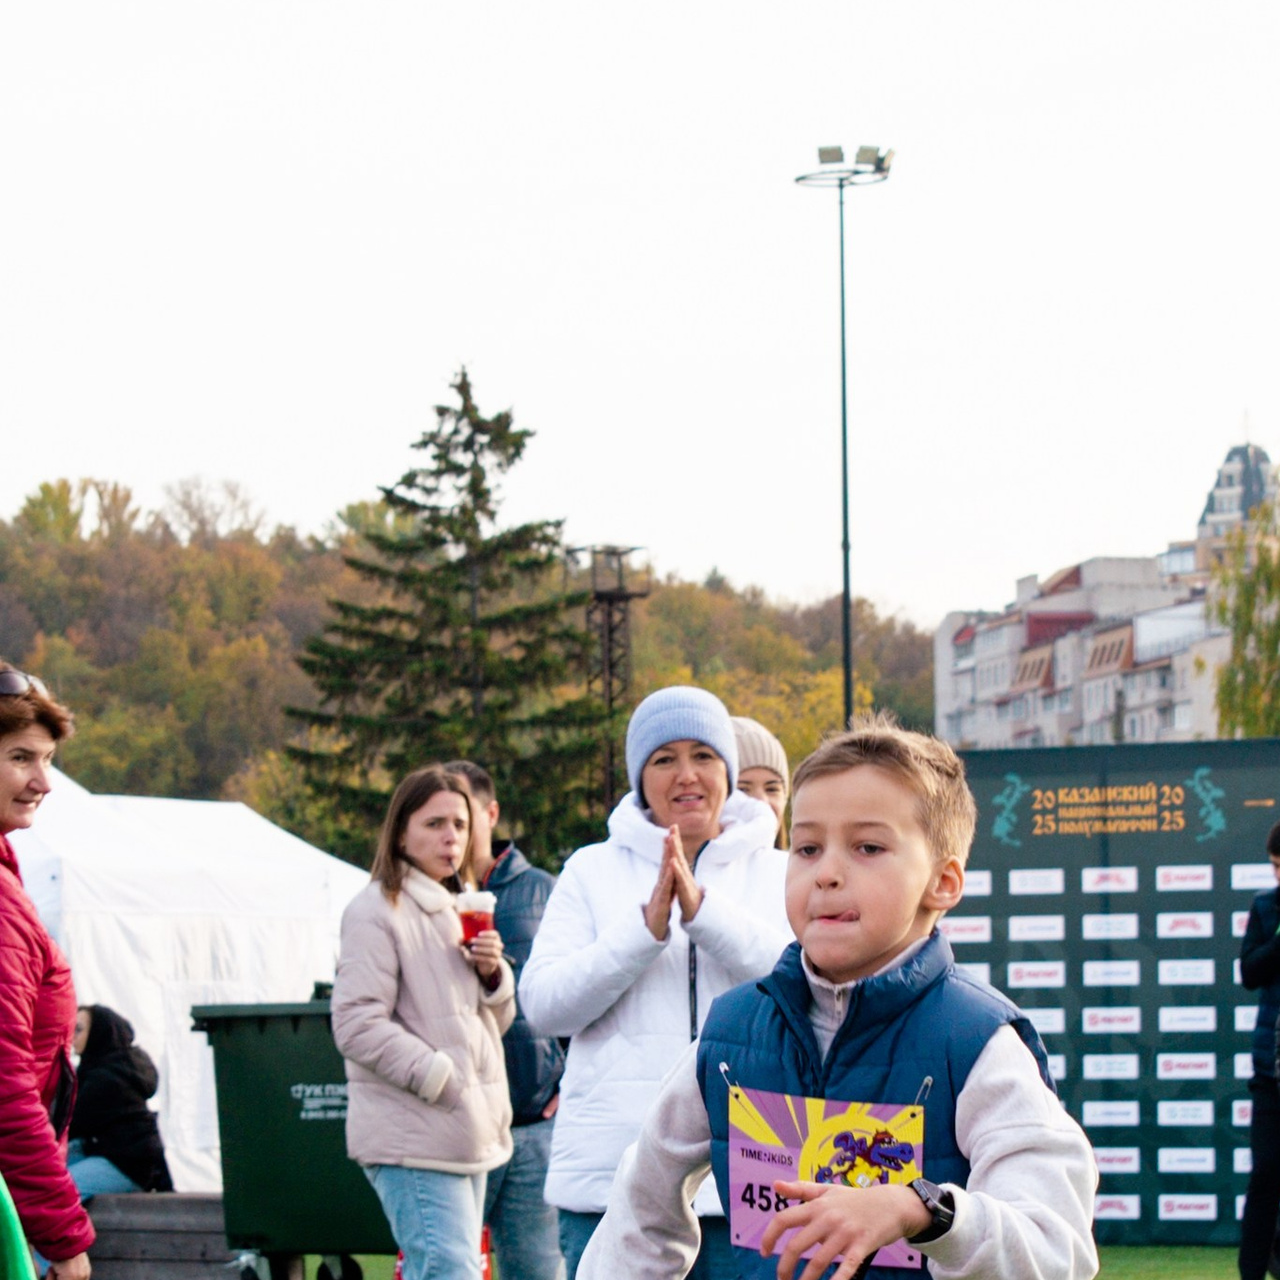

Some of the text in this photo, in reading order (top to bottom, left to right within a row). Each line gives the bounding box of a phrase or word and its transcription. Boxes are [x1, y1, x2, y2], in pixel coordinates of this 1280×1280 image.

[1031, 782, 1185, 810] 20 КАЗАНСКИЙ 20
[1032, 814, 1057, 836] 25
[1160, 810, 1186, 831] 25
